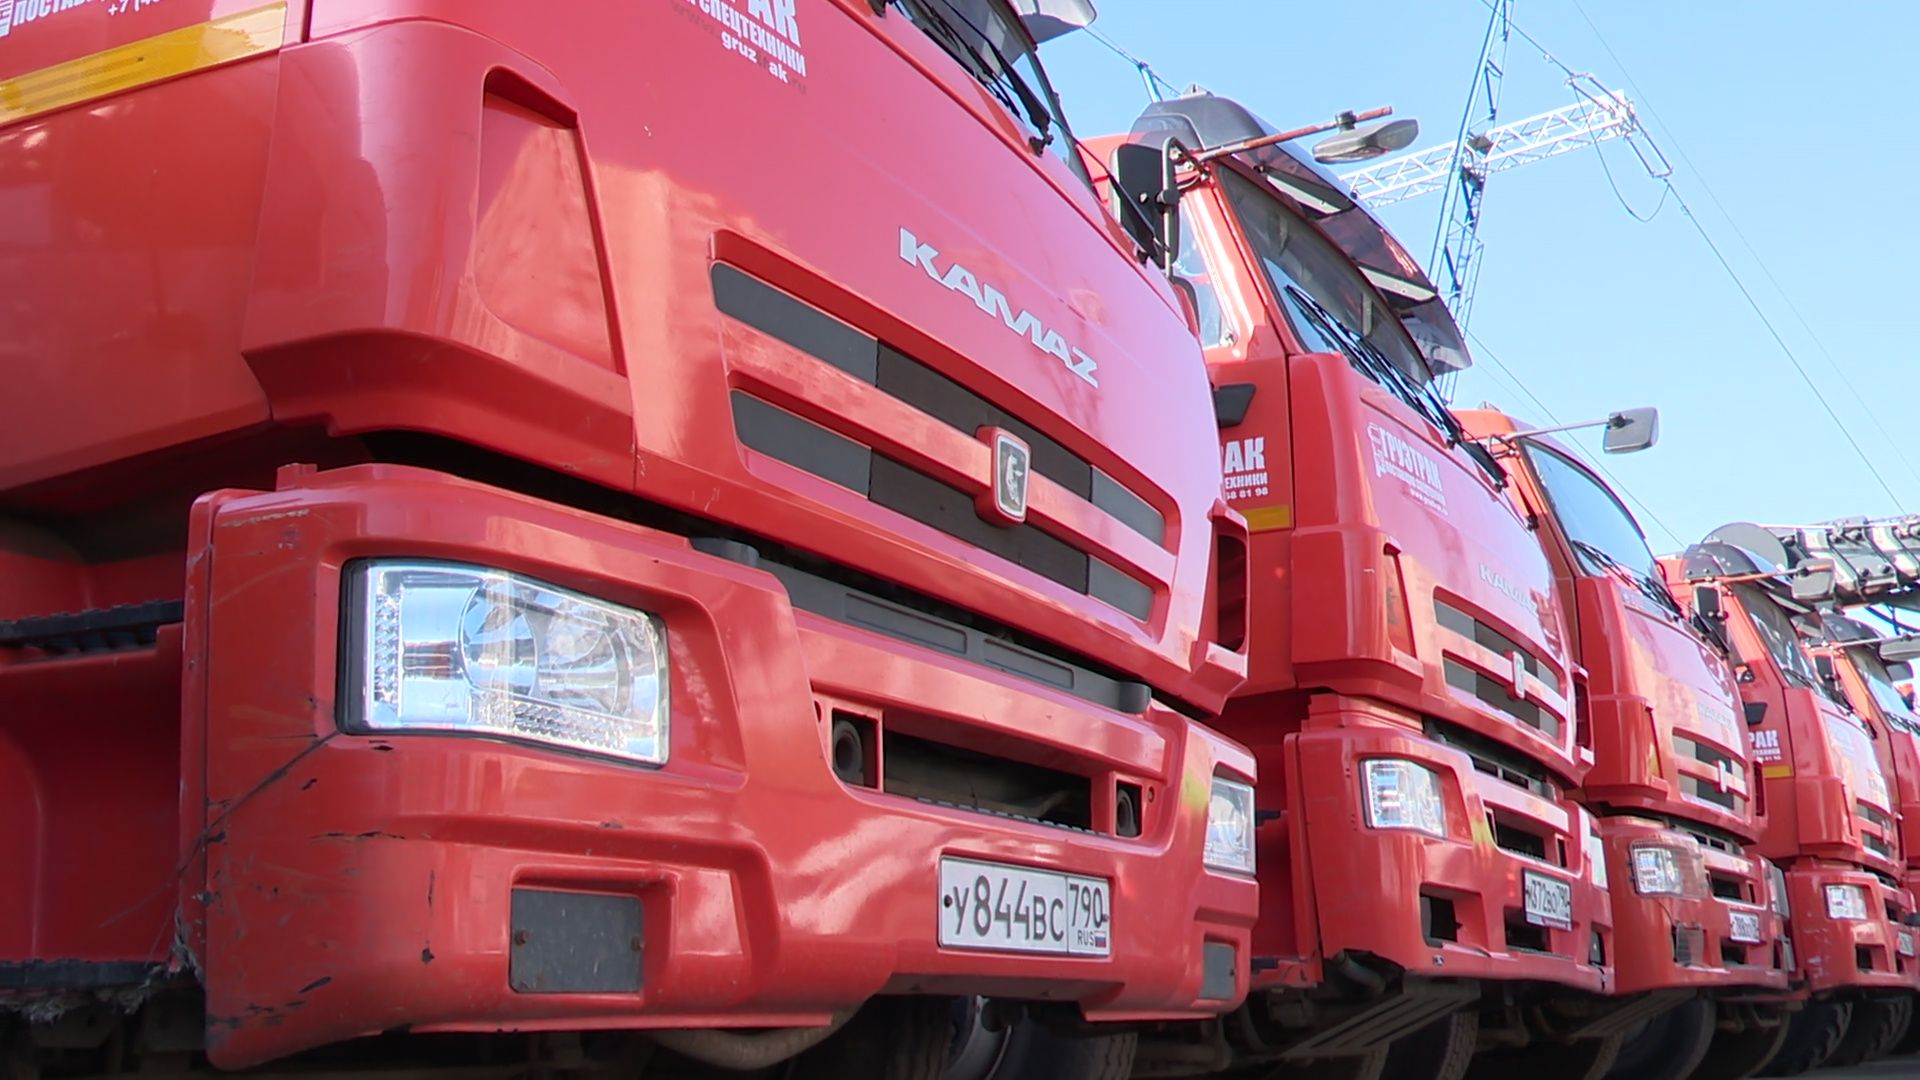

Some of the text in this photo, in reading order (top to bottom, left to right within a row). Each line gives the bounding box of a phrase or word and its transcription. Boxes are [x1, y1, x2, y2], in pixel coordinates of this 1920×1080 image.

[899, 227, 1098, 389] KAMAZ
[1069, 883, 1103, 929] 790
[1077, 929, 1095, 946] RUS
